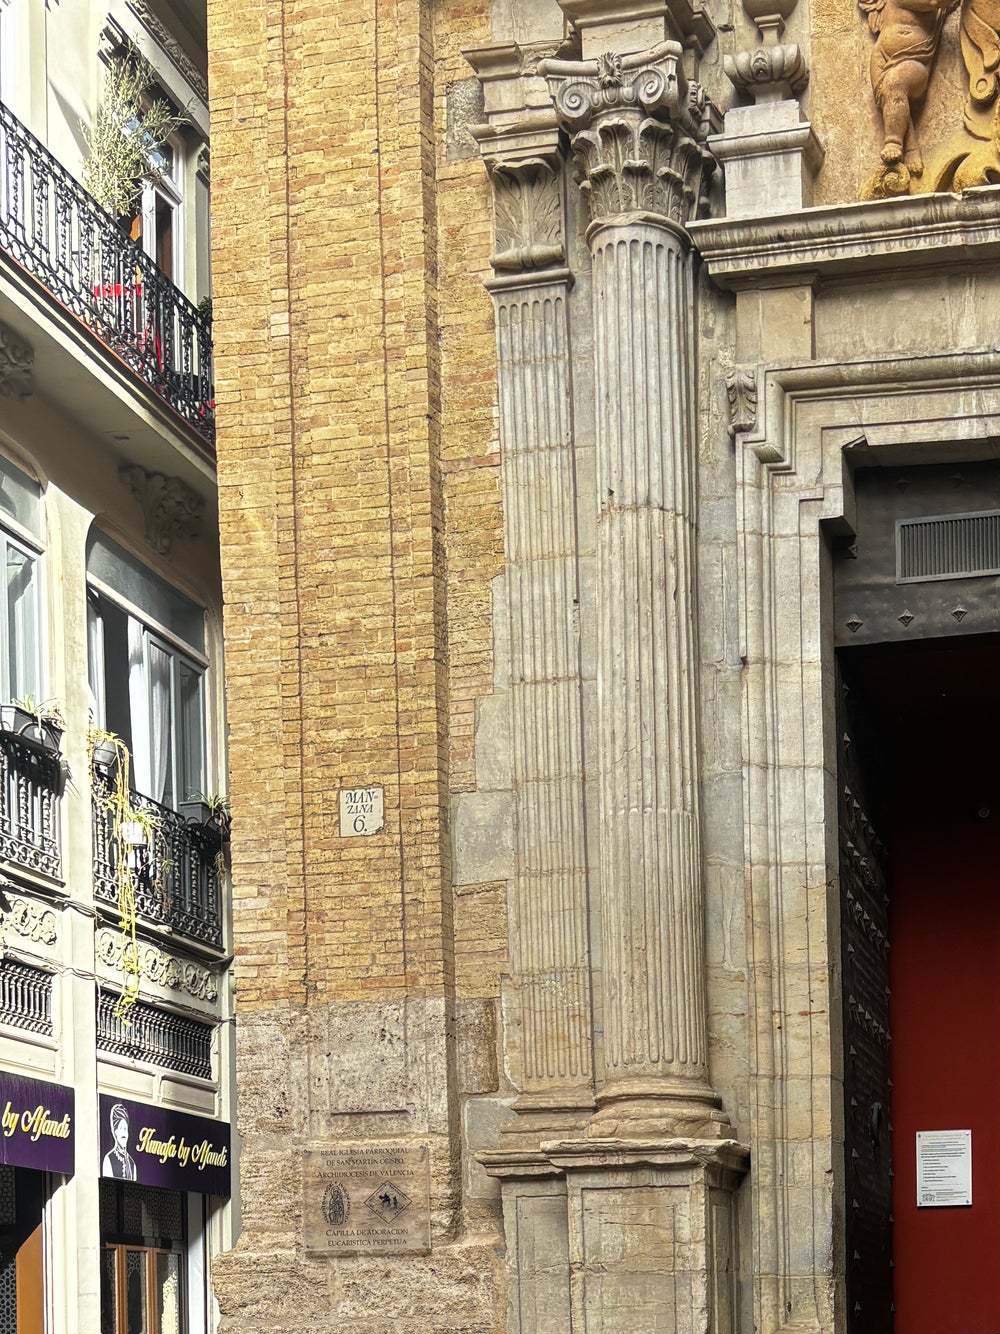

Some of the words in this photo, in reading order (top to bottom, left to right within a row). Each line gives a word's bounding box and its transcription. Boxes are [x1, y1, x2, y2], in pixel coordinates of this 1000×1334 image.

[345, 791, 379, 804] MAN-
[346, 804, 373, 814] ZANA
[353, 815, 368, 833] 6.
[2, 1101, 20, 1137] by
[21, 1105, 71, 1142] Afandi
[136, 1127, 177, 1164] Kunafa
[178, 1138, 190, 1168] by
[191, 1139, 228, 1171] Afandi
[365, 1147, 409, 1155] PARROQUIAL
[380, 1169, 415, 1177] VALENCIA
